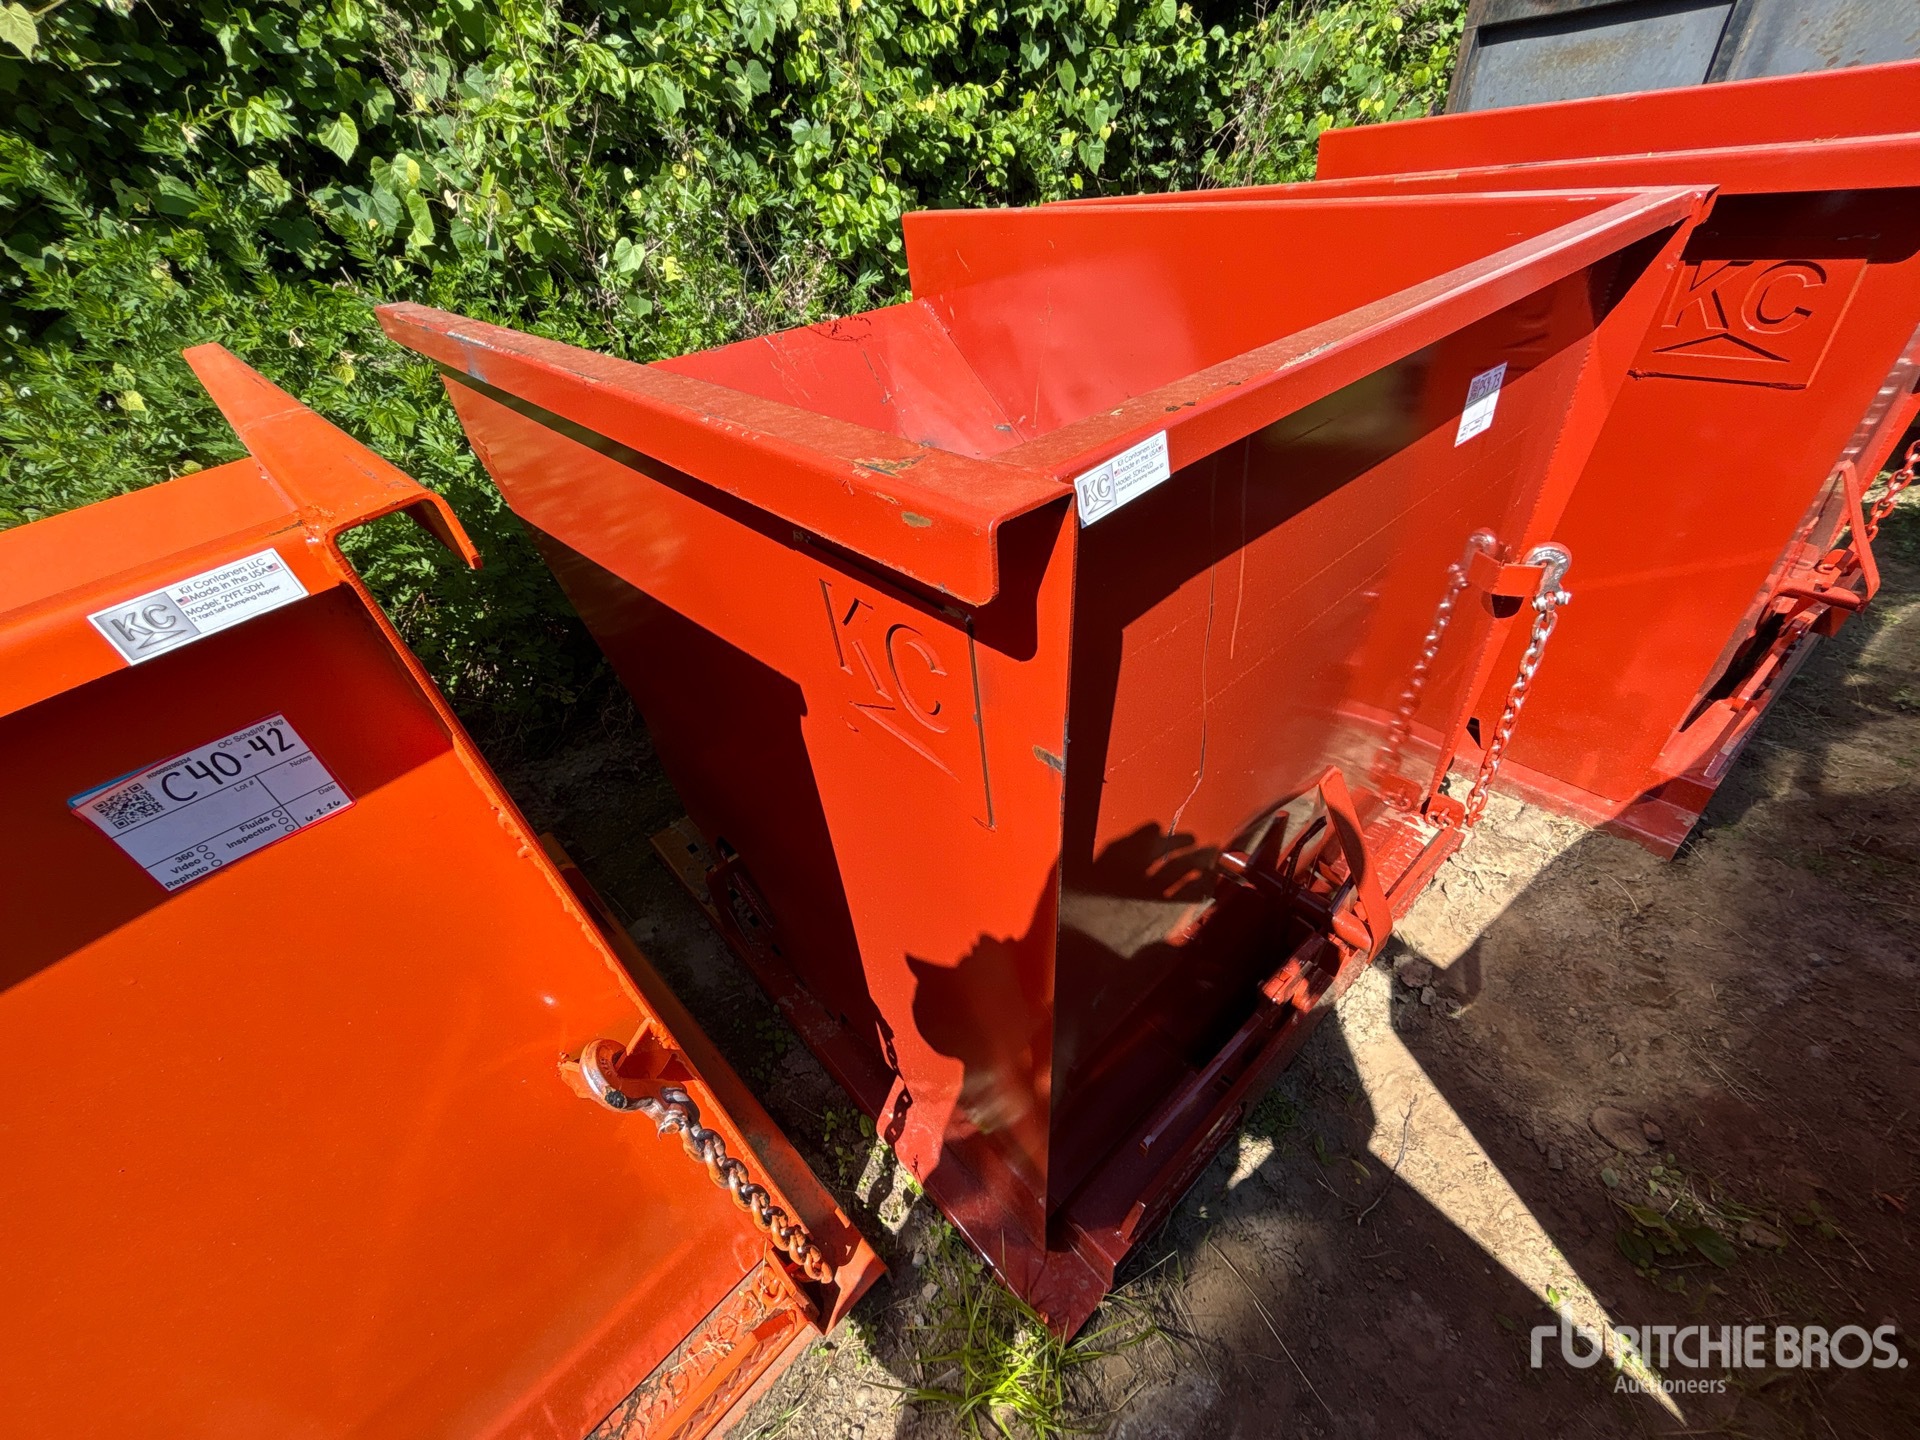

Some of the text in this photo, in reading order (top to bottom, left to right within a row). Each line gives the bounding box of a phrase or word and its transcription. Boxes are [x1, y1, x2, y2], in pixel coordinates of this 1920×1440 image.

[1661, 259, 1827, 335] KC
[1120, 462, 1135, 472] Made
[1149, 448, 1158, 457] USA
[1124, 446, 1150, 463] Containers
[1150, 439, 1159, 449] LLC
[1082, 473, 1111, 507] KC
[178, 558, 266, 595] Kit Containers LLC
[188, 567, 268, 601] Made in the USA
[185, 581, 266, 617] Model: 2YFT-SDH
[199, 610, 215, 620] Yard
[213, 605, 227, 613] Self
[226, 594, 258, 609] Dumping
[256, 585, 281, 598] Hopper
[110, 603, 177, 642] KC
[818, 578, 948, 734] KC
[217, 739, 233, 749] OC
[266, 718, 284, 728] Tag
[289, 755, 313, 768] Notes
[234, 782, 249, 793] Lot
[318, 784, 336, 795] Date
[226, 822, 277, 849] Inspection
[239, 815, 270, 832] Fluids
[170, 858, 201, 874] Video
[174, 851, 195, 863] 360
[164, 866, 209, 889] Rephoto
